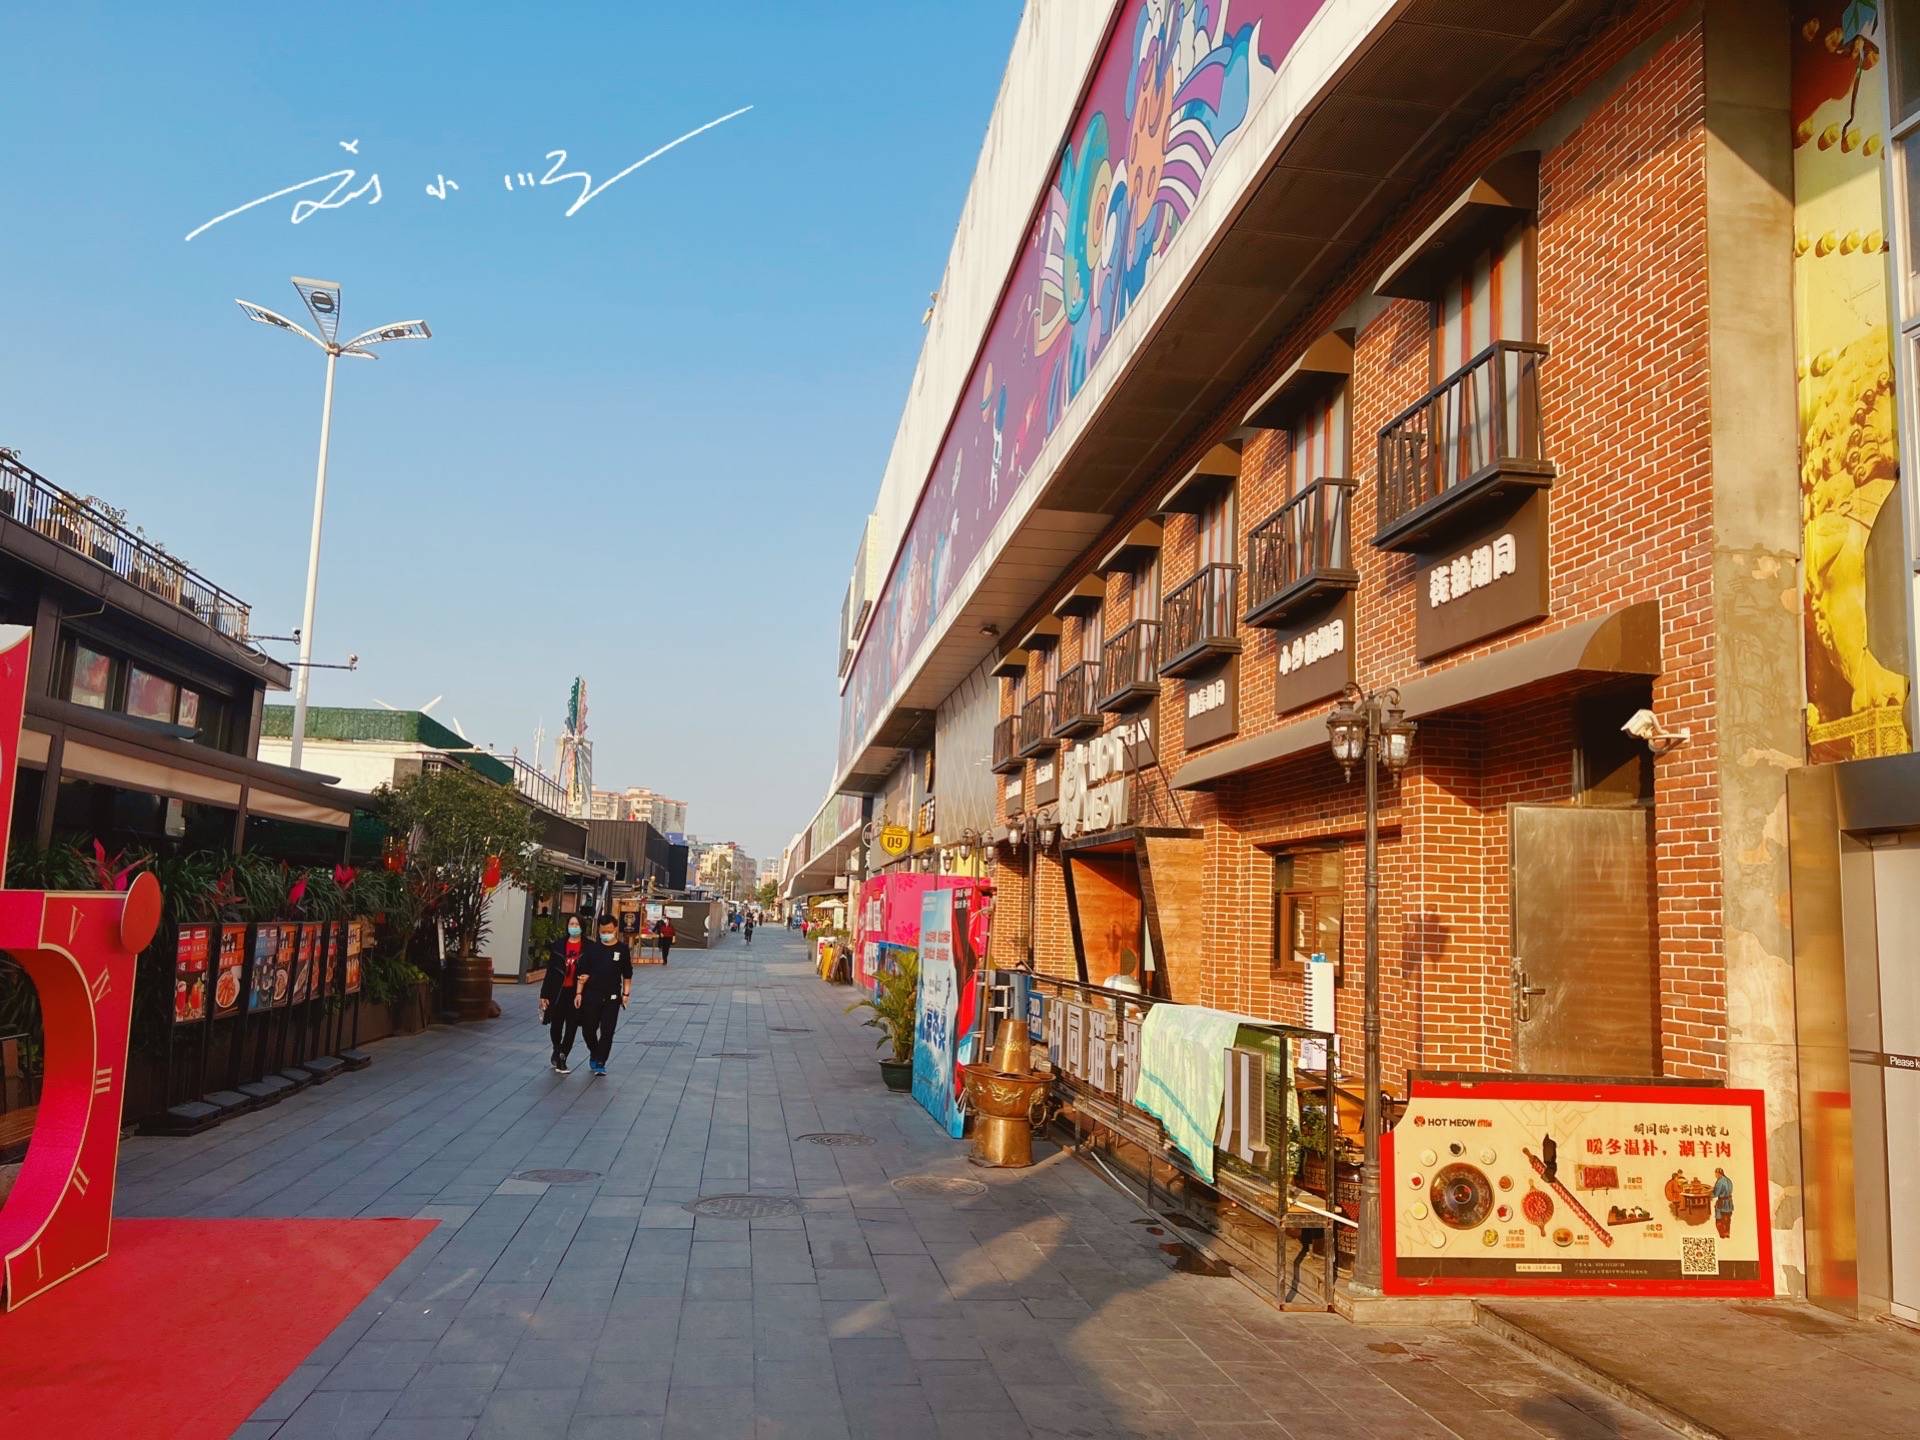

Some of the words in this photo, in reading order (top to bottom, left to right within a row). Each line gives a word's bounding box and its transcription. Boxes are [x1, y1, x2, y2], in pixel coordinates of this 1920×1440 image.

[887, 836, 903, 849] 09
[1889, 1055, 1915, 1068] Please
[1428, 1118, 1448, 1127] HOT
[1449, 1119, 1477, 1128] MEOW
